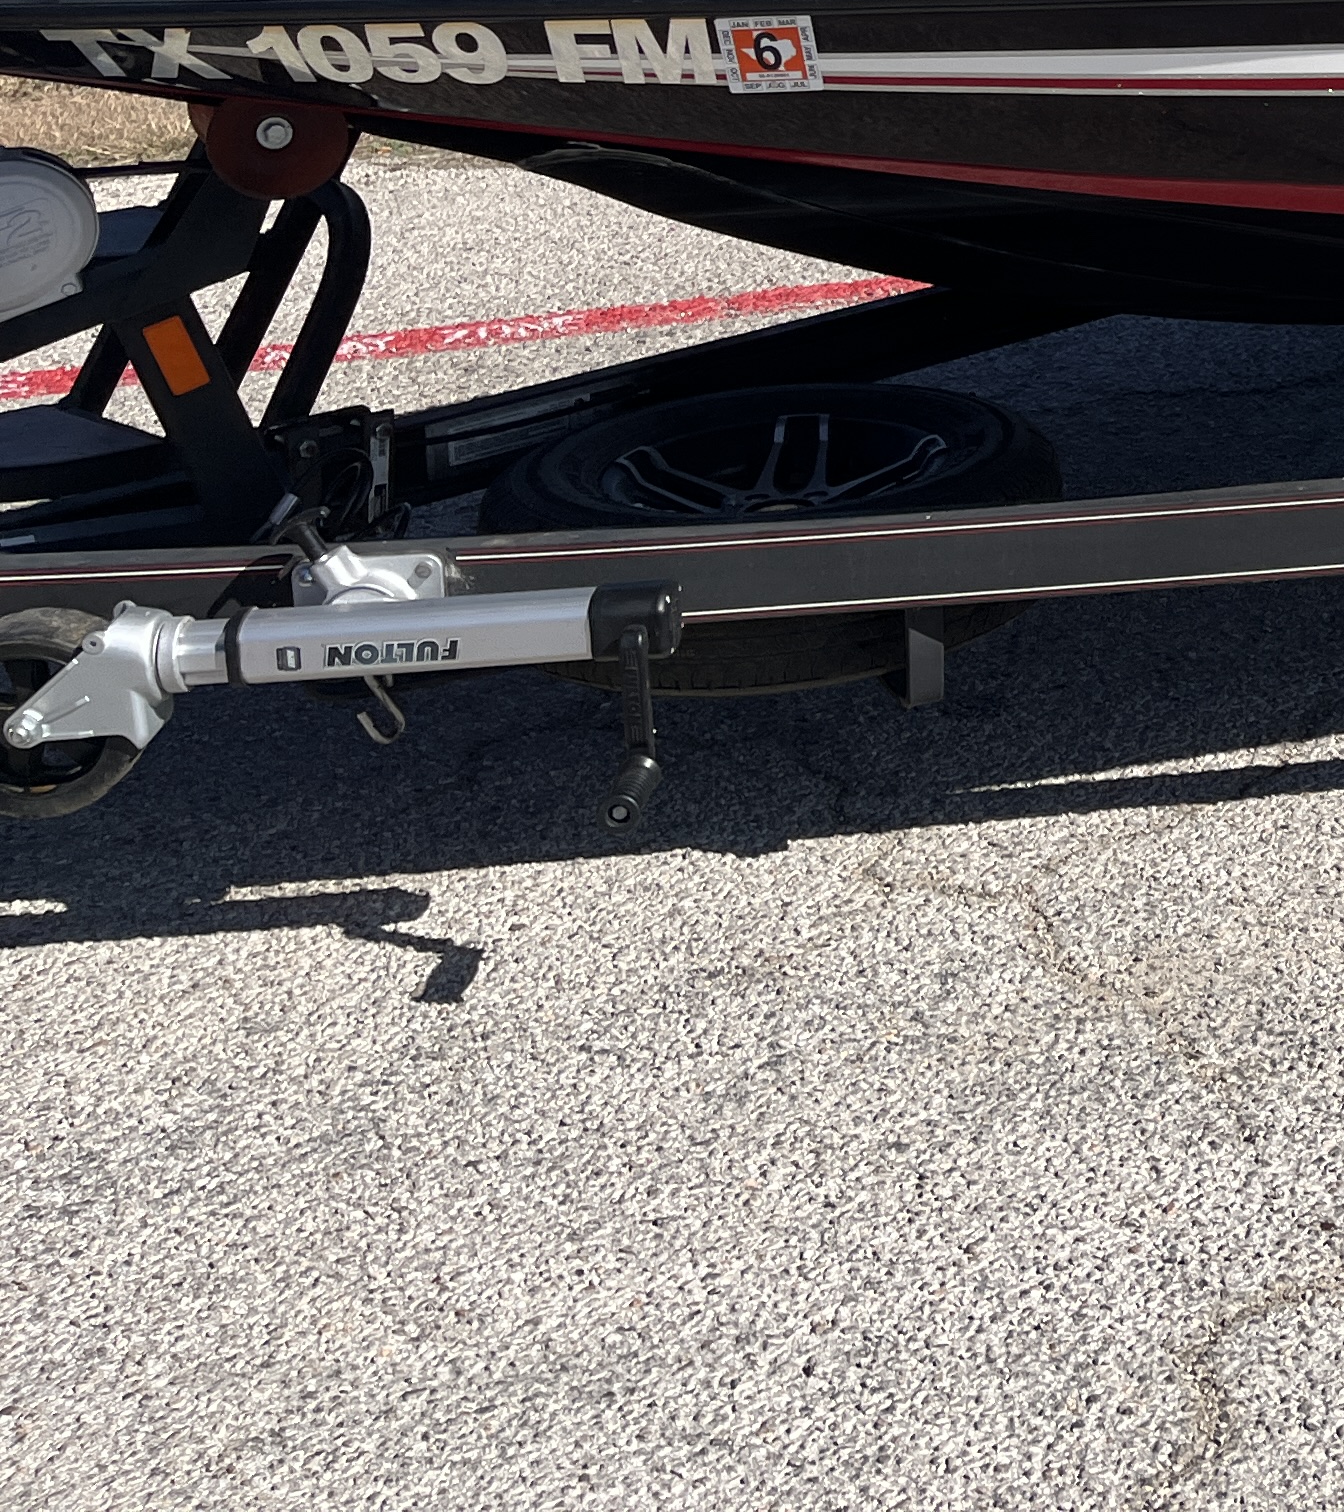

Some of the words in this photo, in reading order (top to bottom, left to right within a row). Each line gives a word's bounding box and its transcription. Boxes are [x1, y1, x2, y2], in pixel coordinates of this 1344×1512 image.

[40, 28, 234, 80] TX
[245, 21, 508, 85] 1059
[543, 17, 718, 85] FM
[753, 31, 783, 71] 6
[323, 638, 462, 670] FULTON
